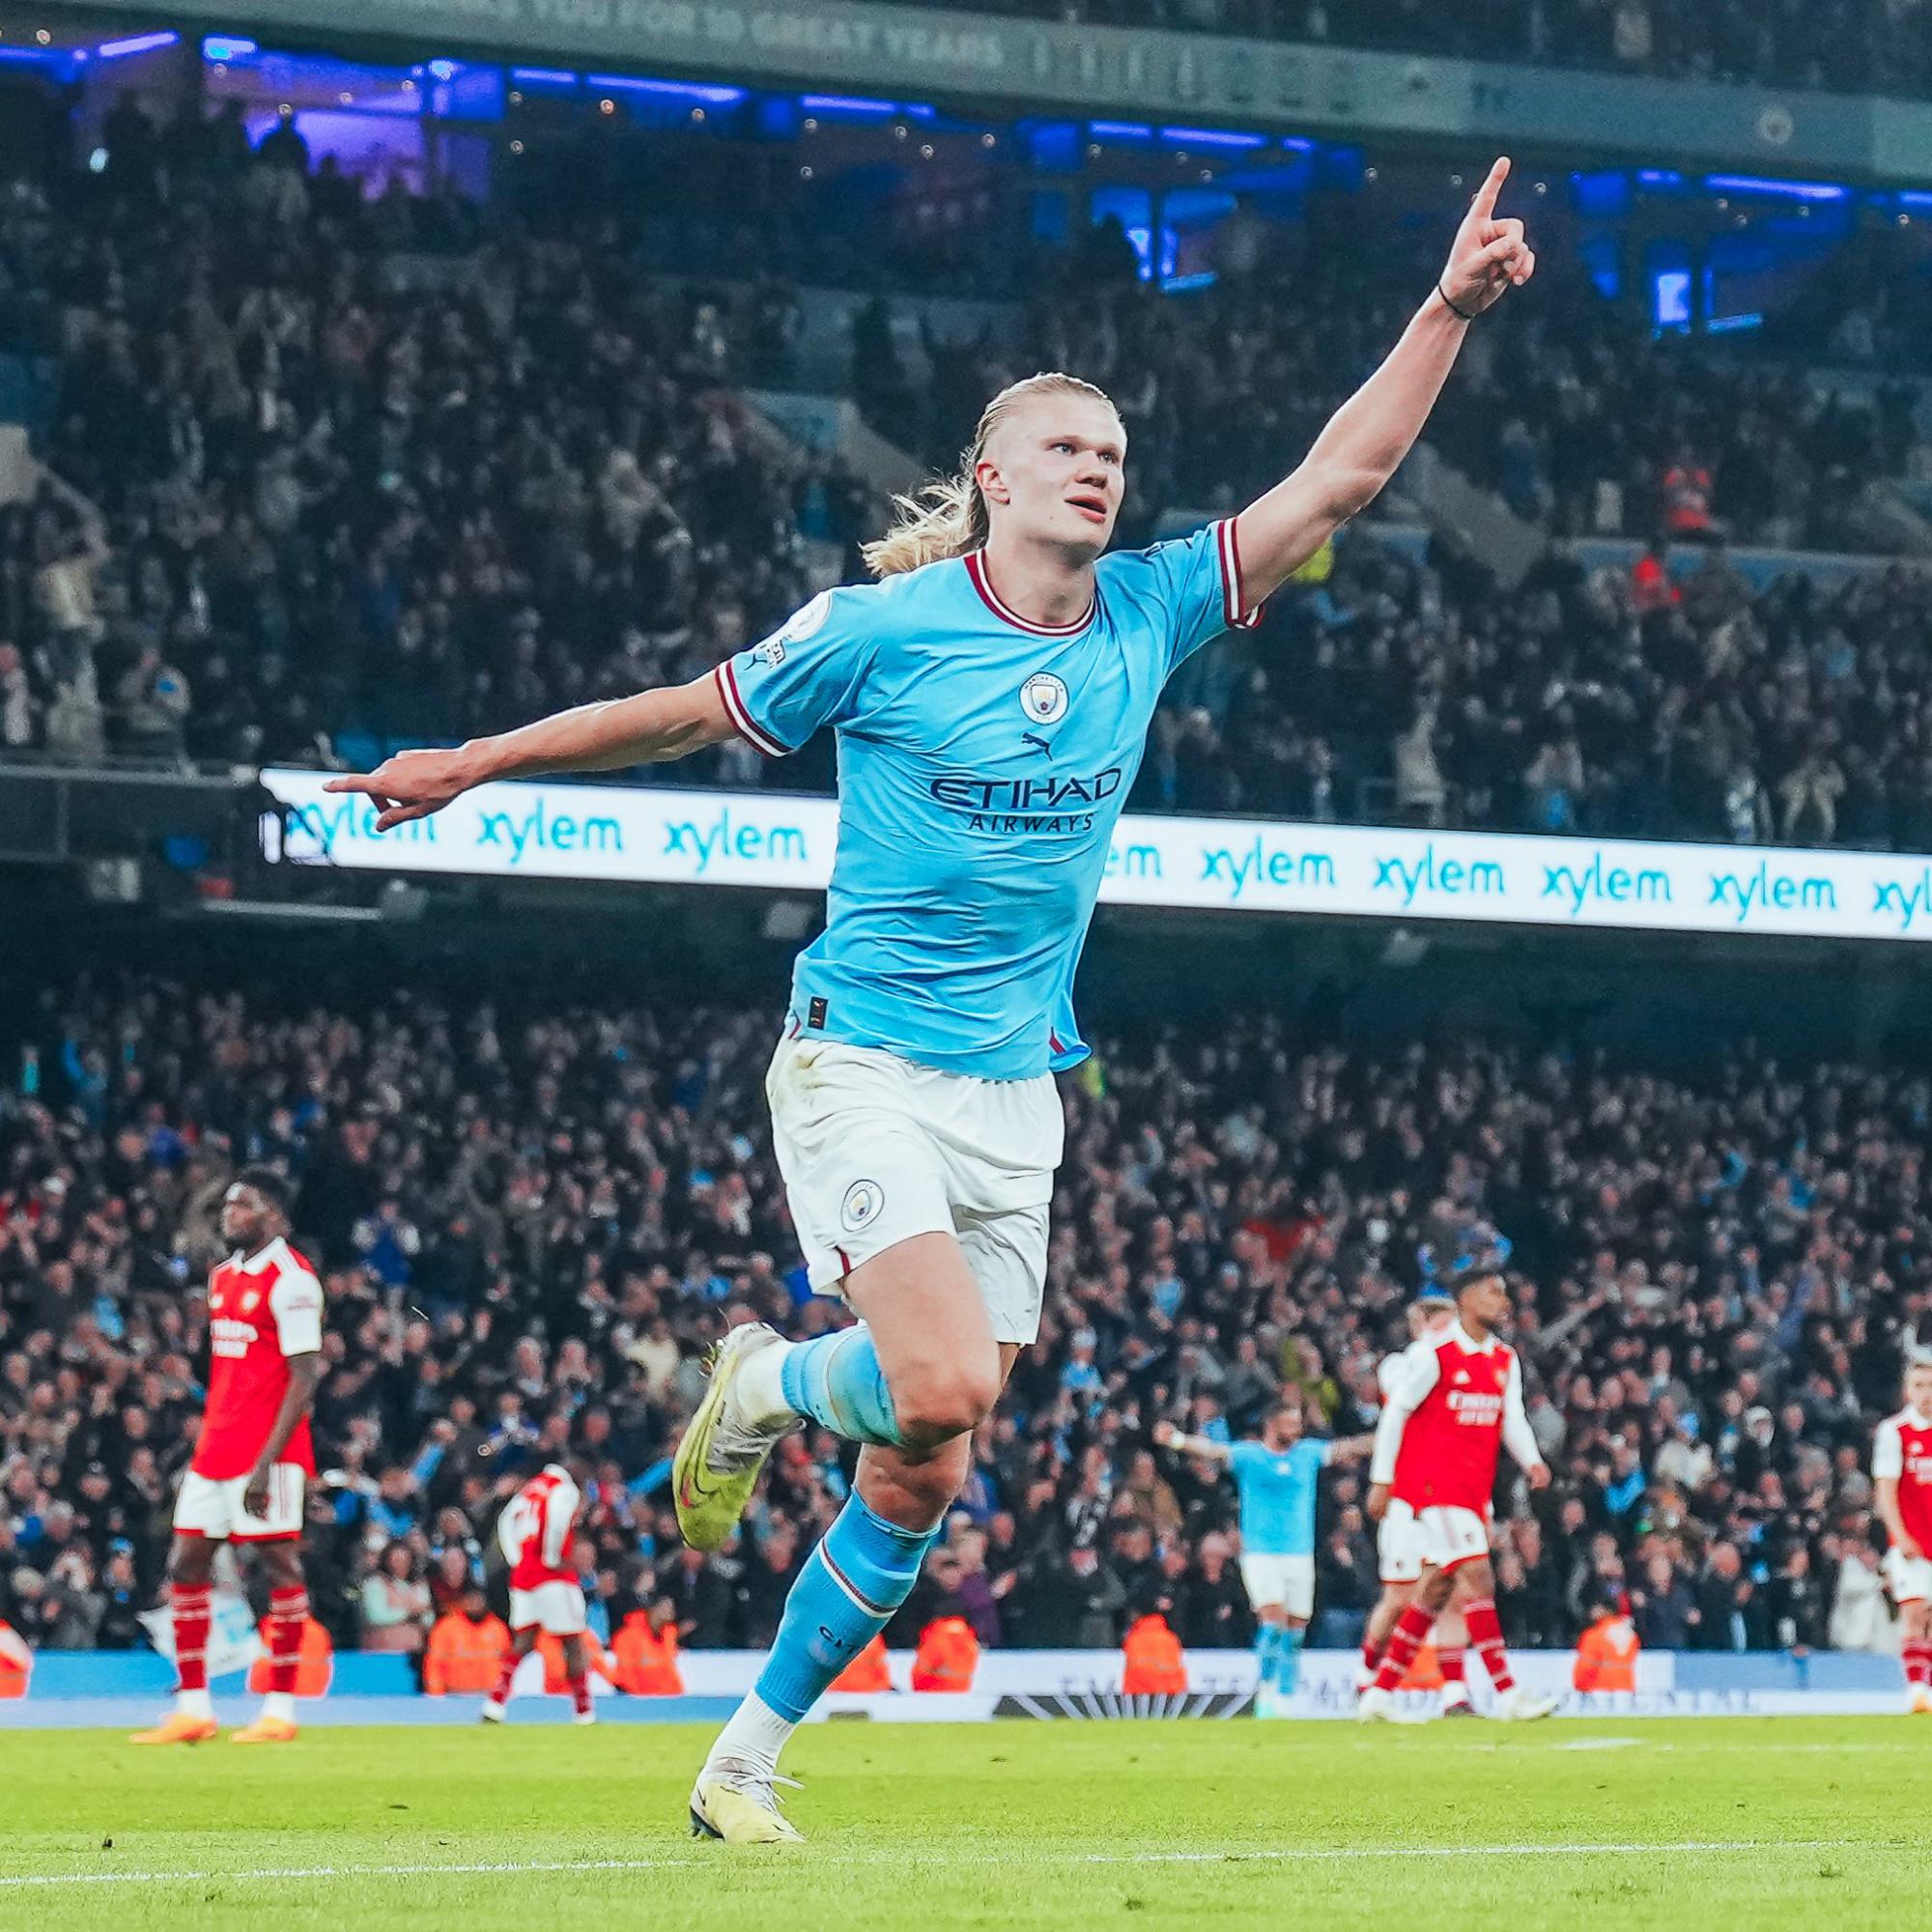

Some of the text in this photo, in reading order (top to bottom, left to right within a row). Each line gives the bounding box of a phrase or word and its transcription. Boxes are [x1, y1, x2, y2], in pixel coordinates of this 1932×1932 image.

[929, 768, 1122, 810] ETIHAD
[968, 812, 1096, 834] AIRWAYS
[476, 796, 623, 866] xylem
[663, 806, 809, 873] xylem
[1200, 834, 1335, 899] xylem
[1373, 841, 1505, 908] xylem
[1542, 850, 1671, 916] xylem
[1708, 860, 1837, 923] xylem
[1872, 865, 1932, 930] xyl
